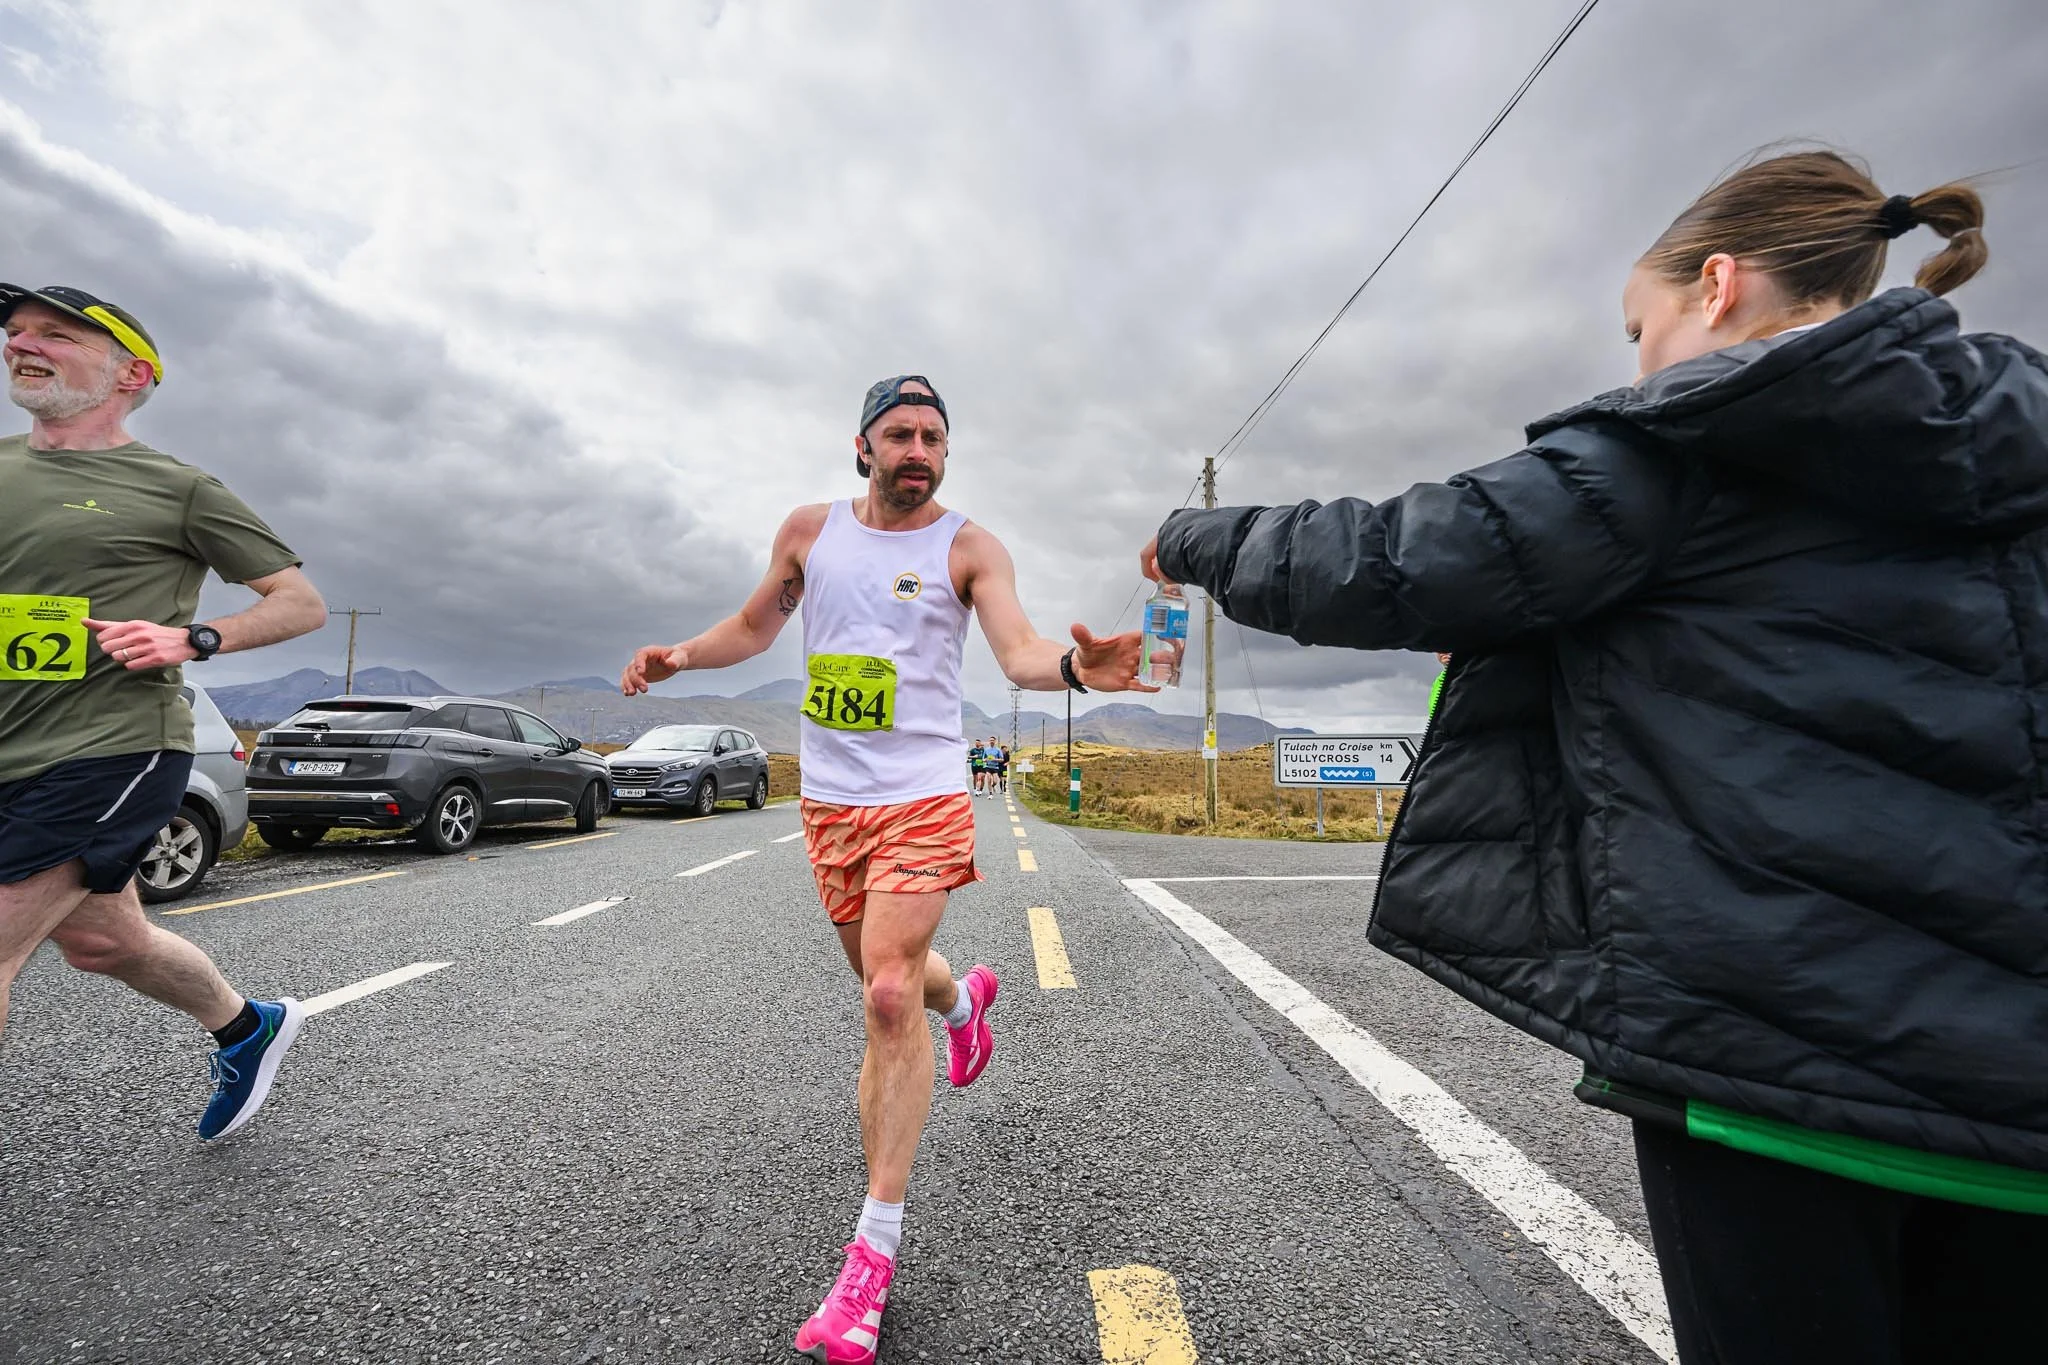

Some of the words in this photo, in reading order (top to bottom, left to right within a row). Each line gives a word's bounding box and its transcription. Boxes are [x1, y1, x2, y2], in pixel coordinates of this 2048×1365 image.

[896, 579, 919, 593] HRC
[0, 631, 73, 672] 62
[804, 685, 887, 726] 5184
[1284, 742, 1318, 751] Tulach
[1338, 742, 1374, 751] Croise
[1284, 754, 1360, 763] TULLYCROSS
[1380, 754, 1393, 763] 14
[297, 763, 339, 772] 241-D-13122
[1284, 769, 1317, 778] L5102
